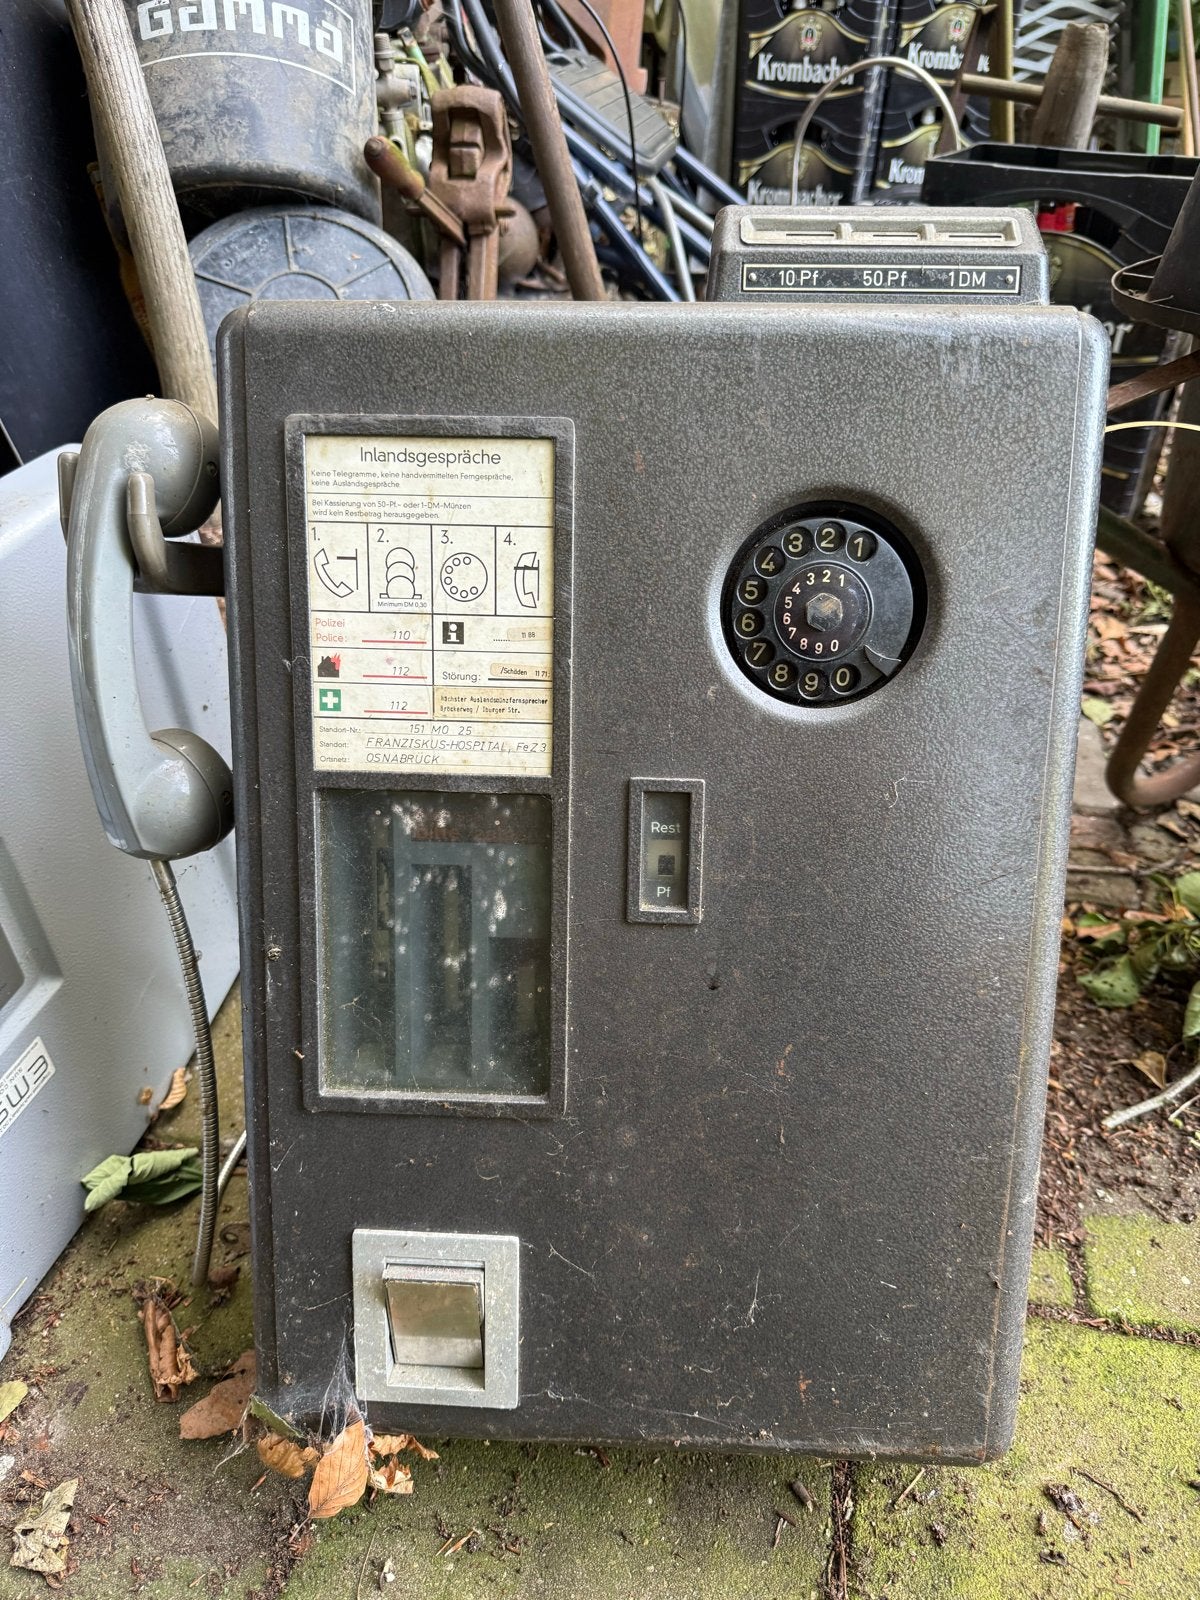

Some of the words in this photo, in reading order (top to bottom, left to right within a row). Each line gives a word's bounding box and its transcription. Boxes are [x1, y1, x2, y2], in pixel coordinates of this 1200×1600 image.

[747, 179, 843, 206] Kromacher
[779, 270, 795, 285] 10
[800, 270, 819, 285] Pf
[863, 271, 882, 286] 50
[887, 271, 908, 287] Pf
[360, 446, 501, 468] Inlandsgespräche
[332, 470, 380, 479] Telegramme,
[401, 472, 459, 480] handvermittelten
[324, 500, 361, 509] Kassierung
[344, 510, 382, 519] Restbetrag
[383, 510, 440, 520] herausgegeben.
[311, 527, 321, 541] 1.
[377, 528, 390, 543] 2.
[440, 530, 454, 544] 3.
[503, 532, 517, 546] 4.
[820, 528, 836, 548] 2
[788, 533, 804, 553] 3
[853, 537, 864, 558] 1
[760, 552, 776, 572] 4
[806, 572, 816, 586] 3
[822, 570, 831, 583] 2
[838, 574, 845, 588] 1
[744, 580, 759, 600] 5
[792, 582, 801, 595] 4
[784, 596, 793, 609] 5
[315, 618, 345, 628] Polizei
[741, 612, 756, 632] 6
[782, 612, 792, 625] 6
[392, 630, 411, 641] 110
[788, 627, 797, 640] 7
[800, 638, 808, 650] 8
[814, 642, 824, 655] 9
[830, 639, 839, 652] 0
[752, 642, 767, 661] 7
[393, 666, 410, 676] 112
[442, 671, 481, 683] Störung:
[774, 664, 789, 682] 8
[836, 667, 850, 687] 0
[804, 672, 819, 692] 9
[390, 700, 408, 711] 112
[409, 724, 425, 734] 151
[458, 726, 472, 736] 25
[366, 737, 511, 754] FRANZISKUS-HOSPITAL,
[366, 751, 440, 764] OSNABRÜCK
[650, 821, 681, 834] Rest
[656, 886, 672, 898] Pf
